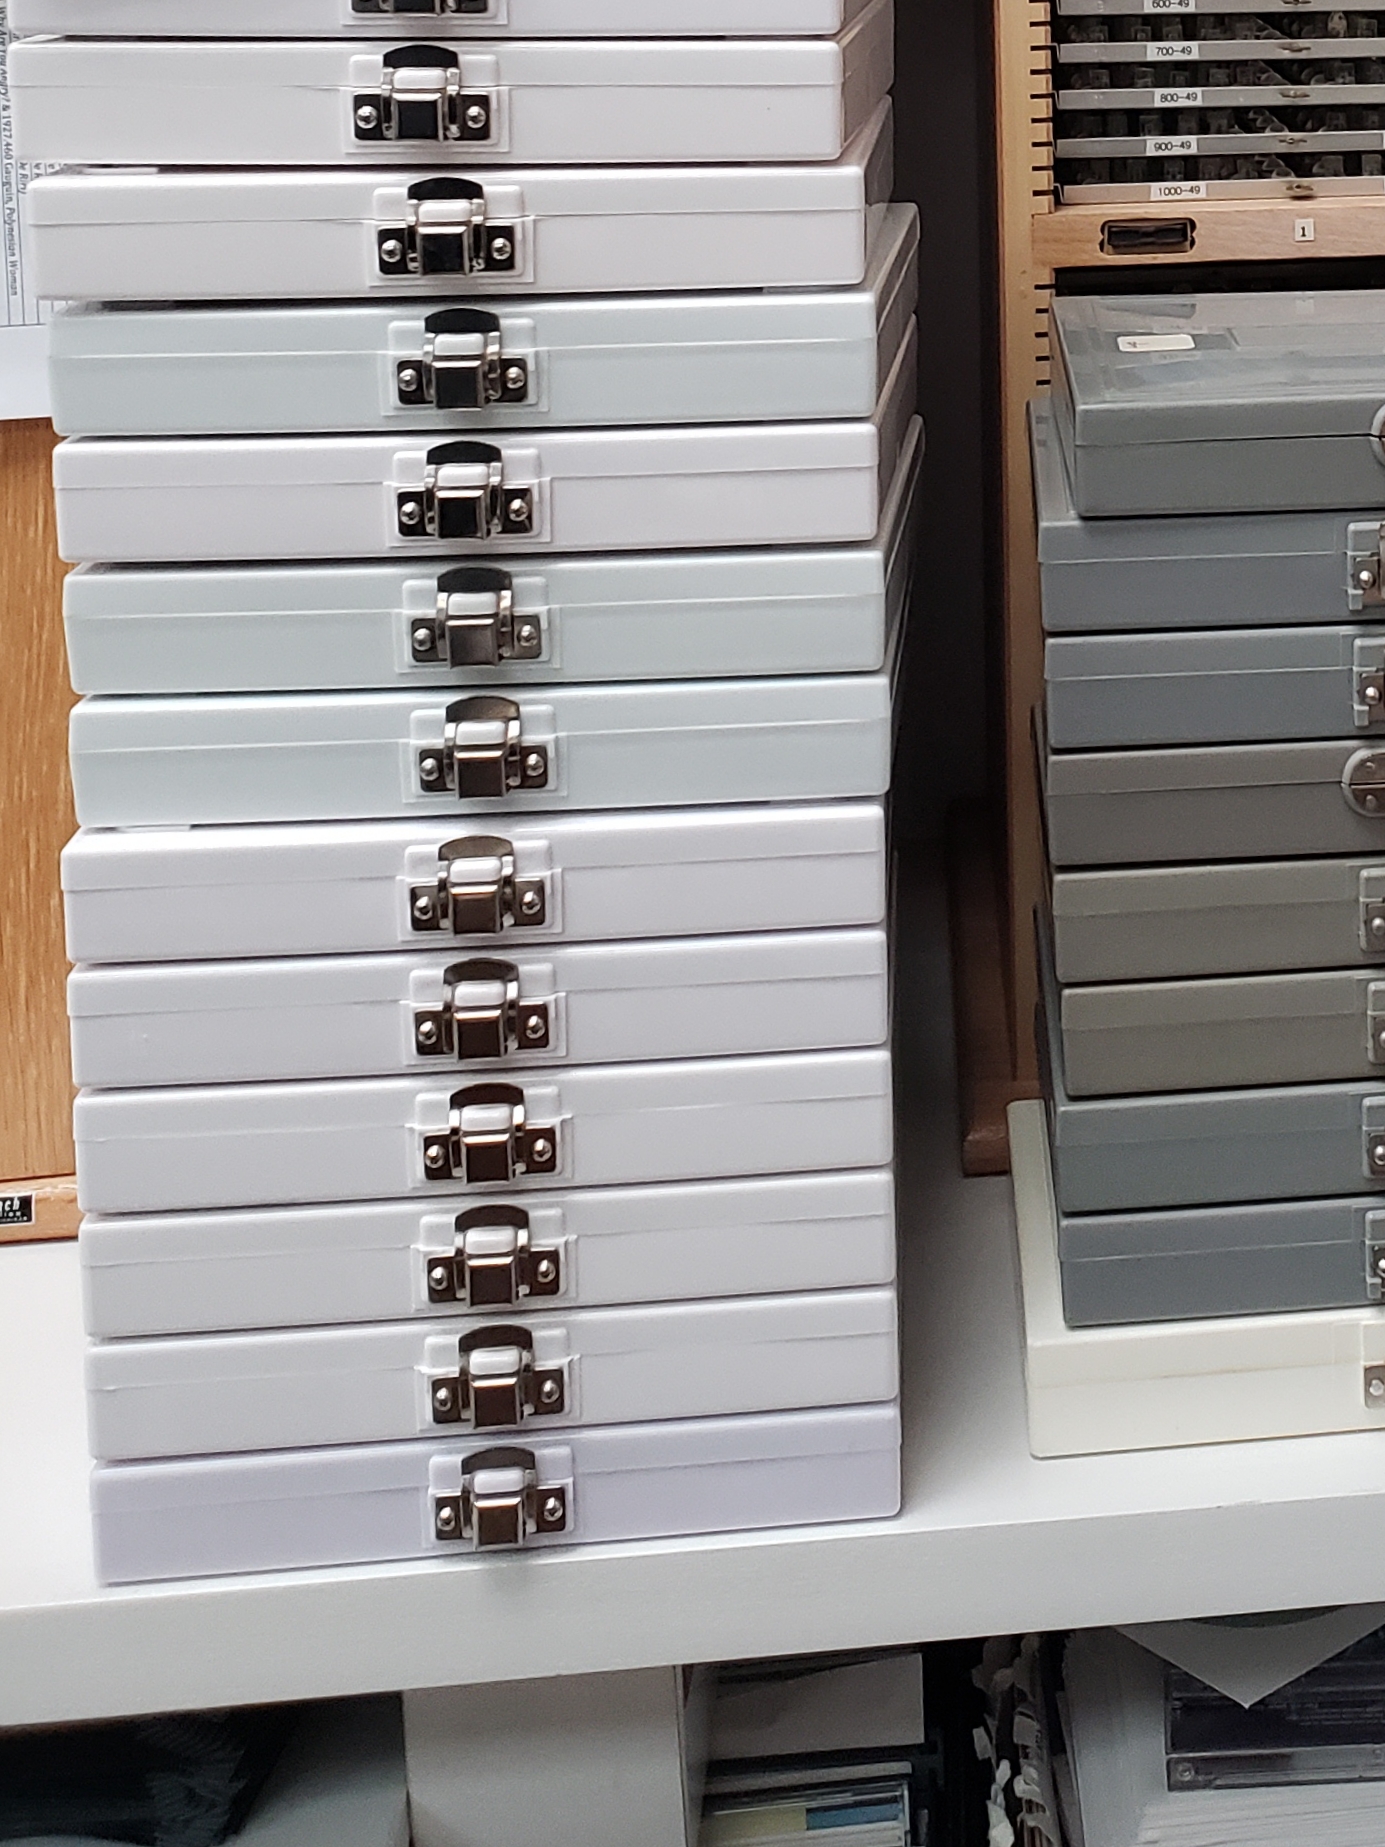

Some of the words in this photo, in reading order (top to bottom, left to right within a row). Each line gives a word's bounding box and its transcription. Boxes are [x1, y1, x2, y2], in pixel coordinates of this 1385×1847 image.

[1155, 46, 1192, 56] 700-49
[1160, 92, 1197, 102] 800-49
[1154, 141, 1191, 151] 900-49
[1158, 185, 1201, 196] 1000-49
[1301, 227, 1306, 237] 1
